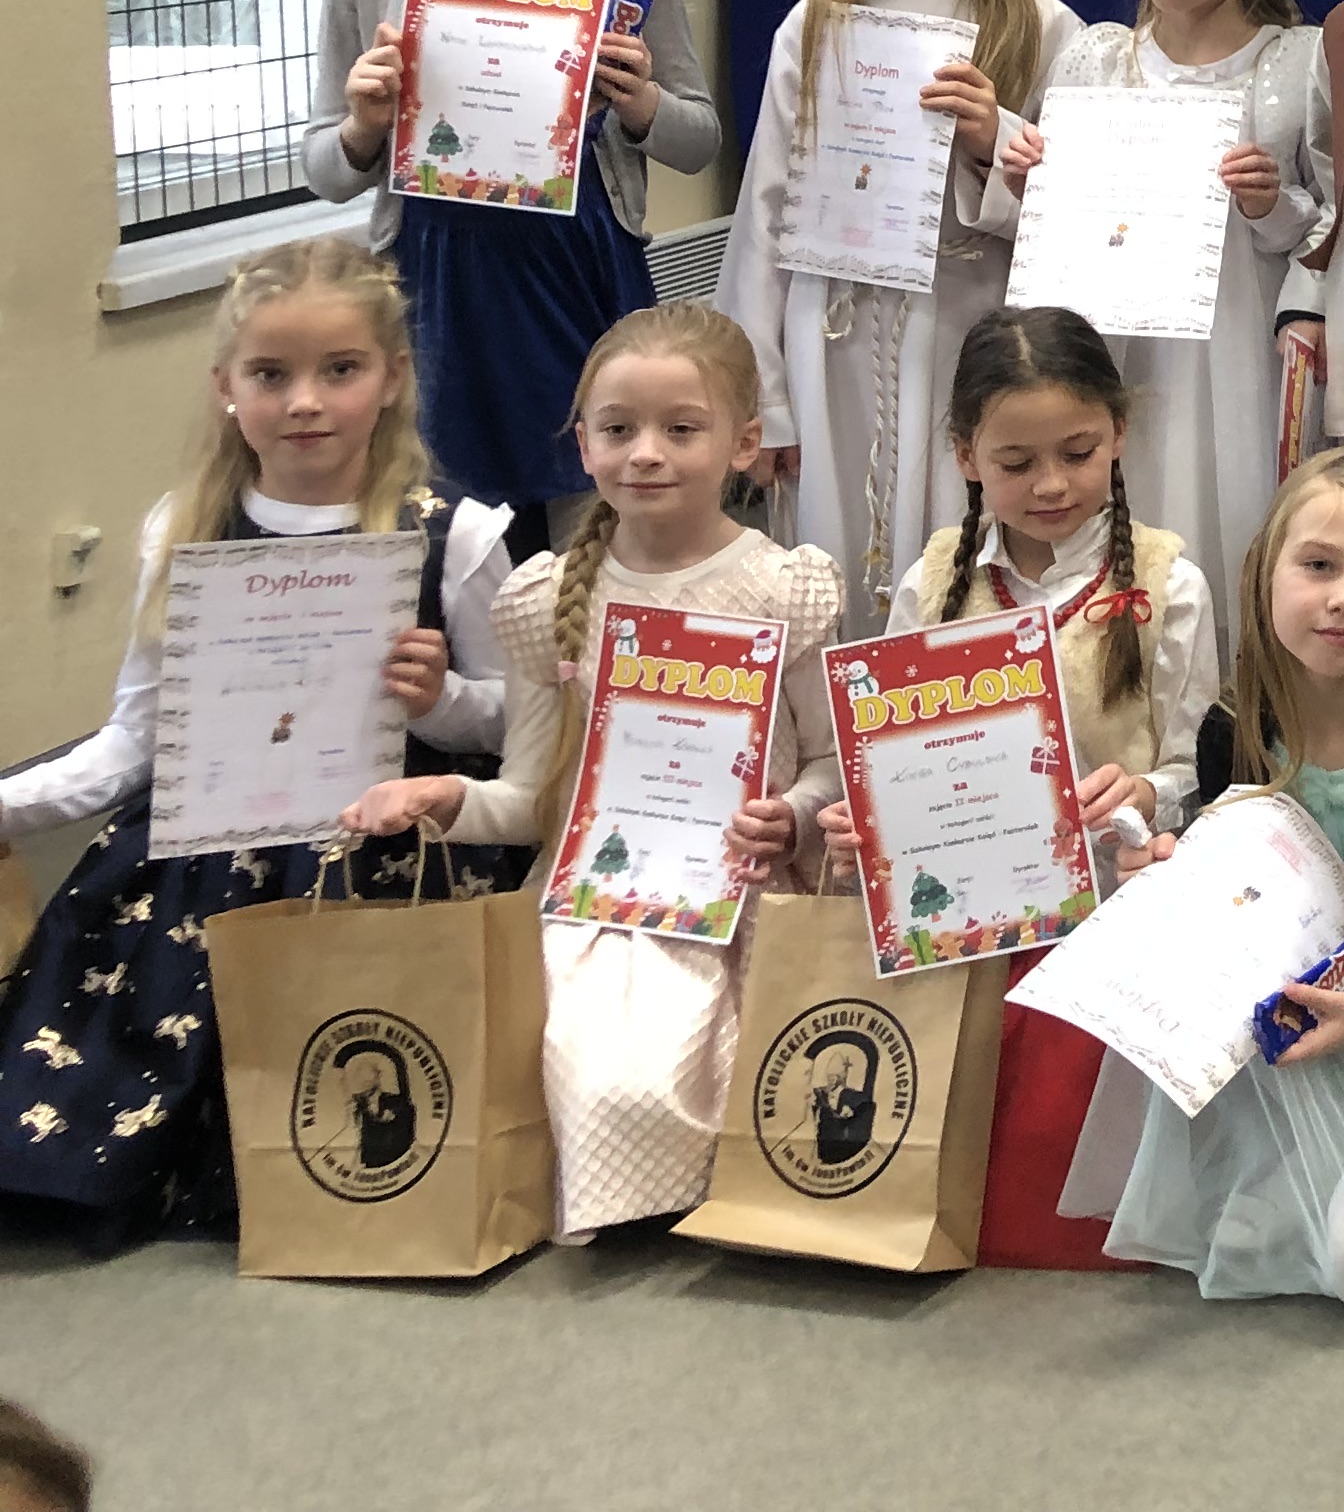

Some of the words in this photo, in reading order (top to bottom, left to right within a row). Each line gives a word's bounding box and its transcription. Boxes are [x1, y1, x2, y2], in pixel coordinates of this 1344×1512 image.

[854, 60, 899, 79] Dyplom
[245, 570, 357, 596] Dyplom
[609, 654, 766, 705] DYPLOM
[853, 659, 1046, 734] DYPLOM
[924, 730, 986, 750] otrzymuje
[952, 782, 968, 791] za
[763, 1028, 810, 1119] KATOLICKIE
[812, 1010, 864, 1034] SZKOŁY
[866, 1016, 910, 1120] NIEPUBLICZNE
